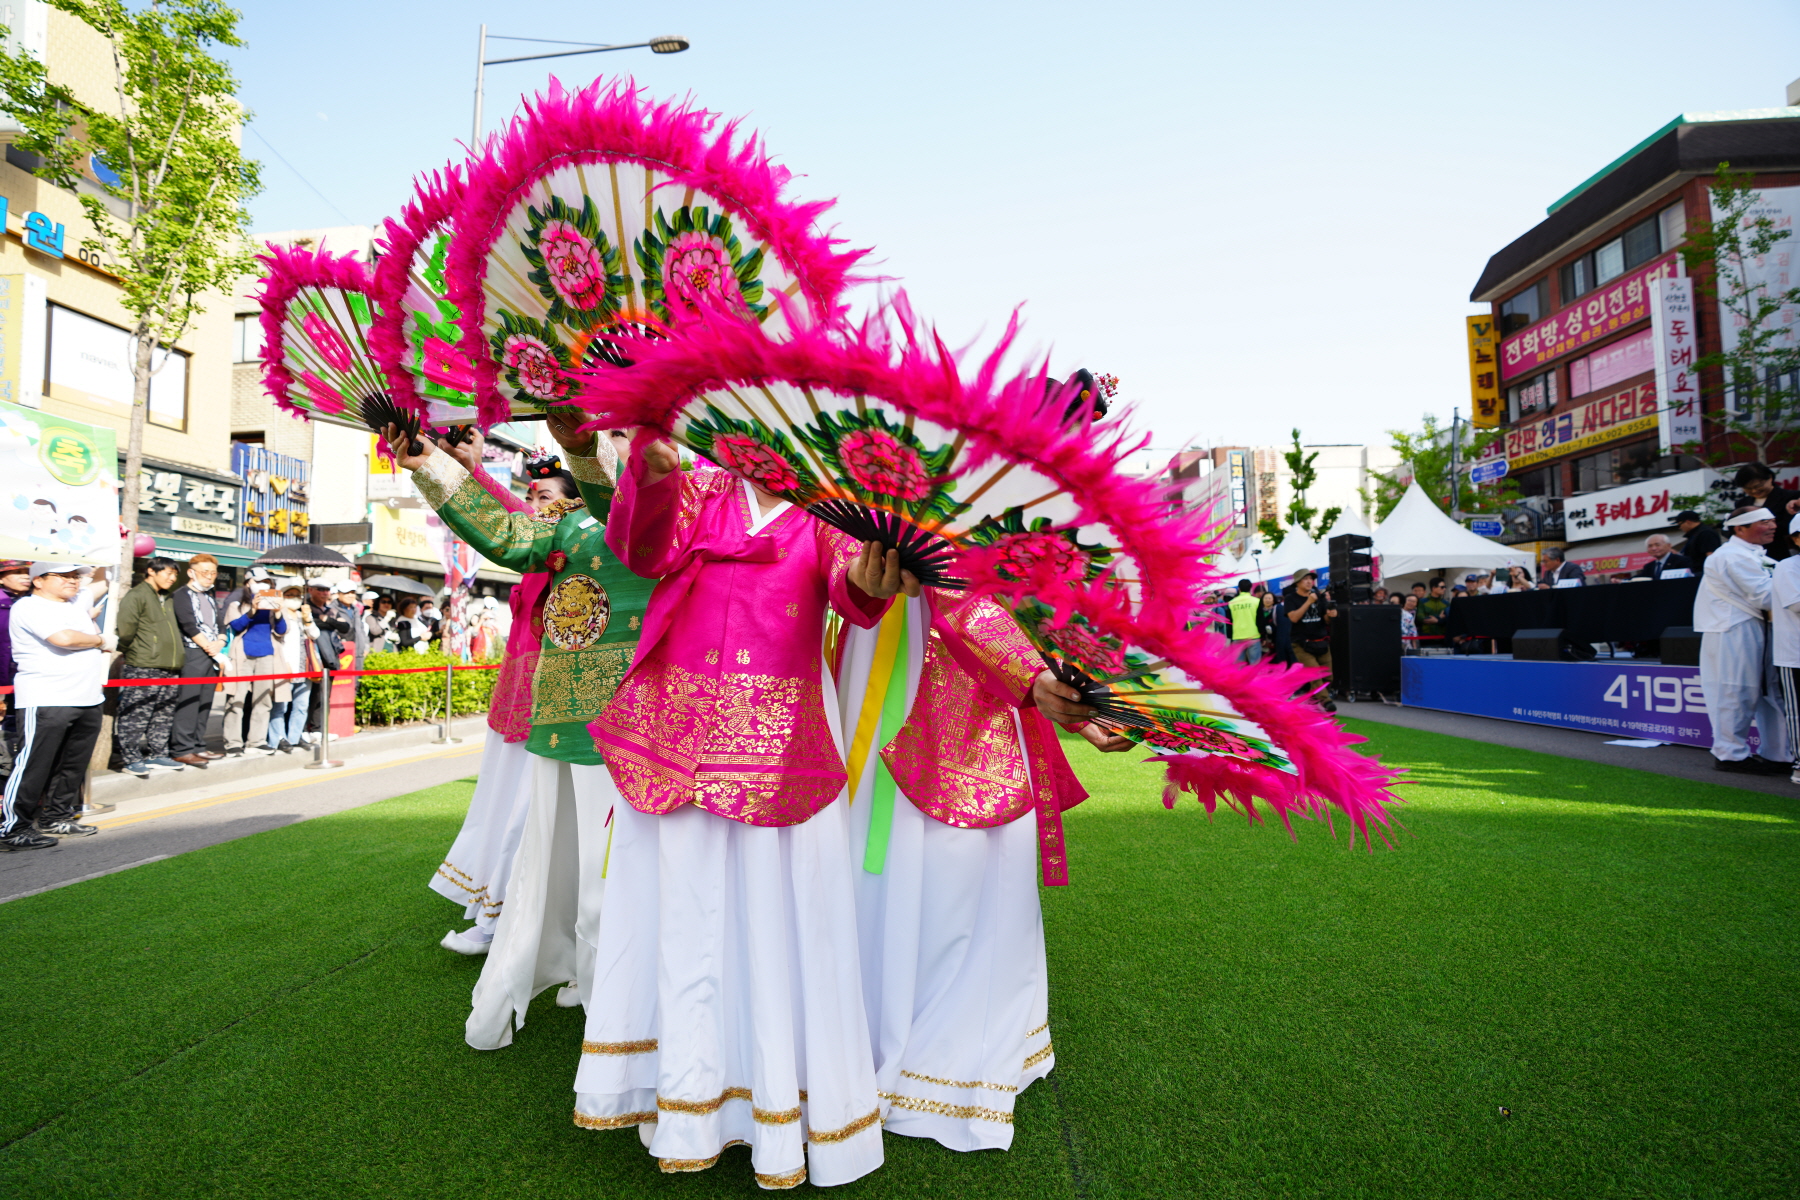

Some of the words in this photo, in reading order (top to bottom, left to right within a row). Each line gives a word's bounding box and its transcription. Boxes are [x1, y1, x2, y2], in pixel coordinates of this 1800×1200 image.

[1475, 349, 1497, 417] 노래방
[52, 438, 87, 474] 축
[1595, 489, 1670, 527] 동태요리
[1232, 603, 1253, 612] STAFF
[1677, 727, 1701, 739] 강북구
